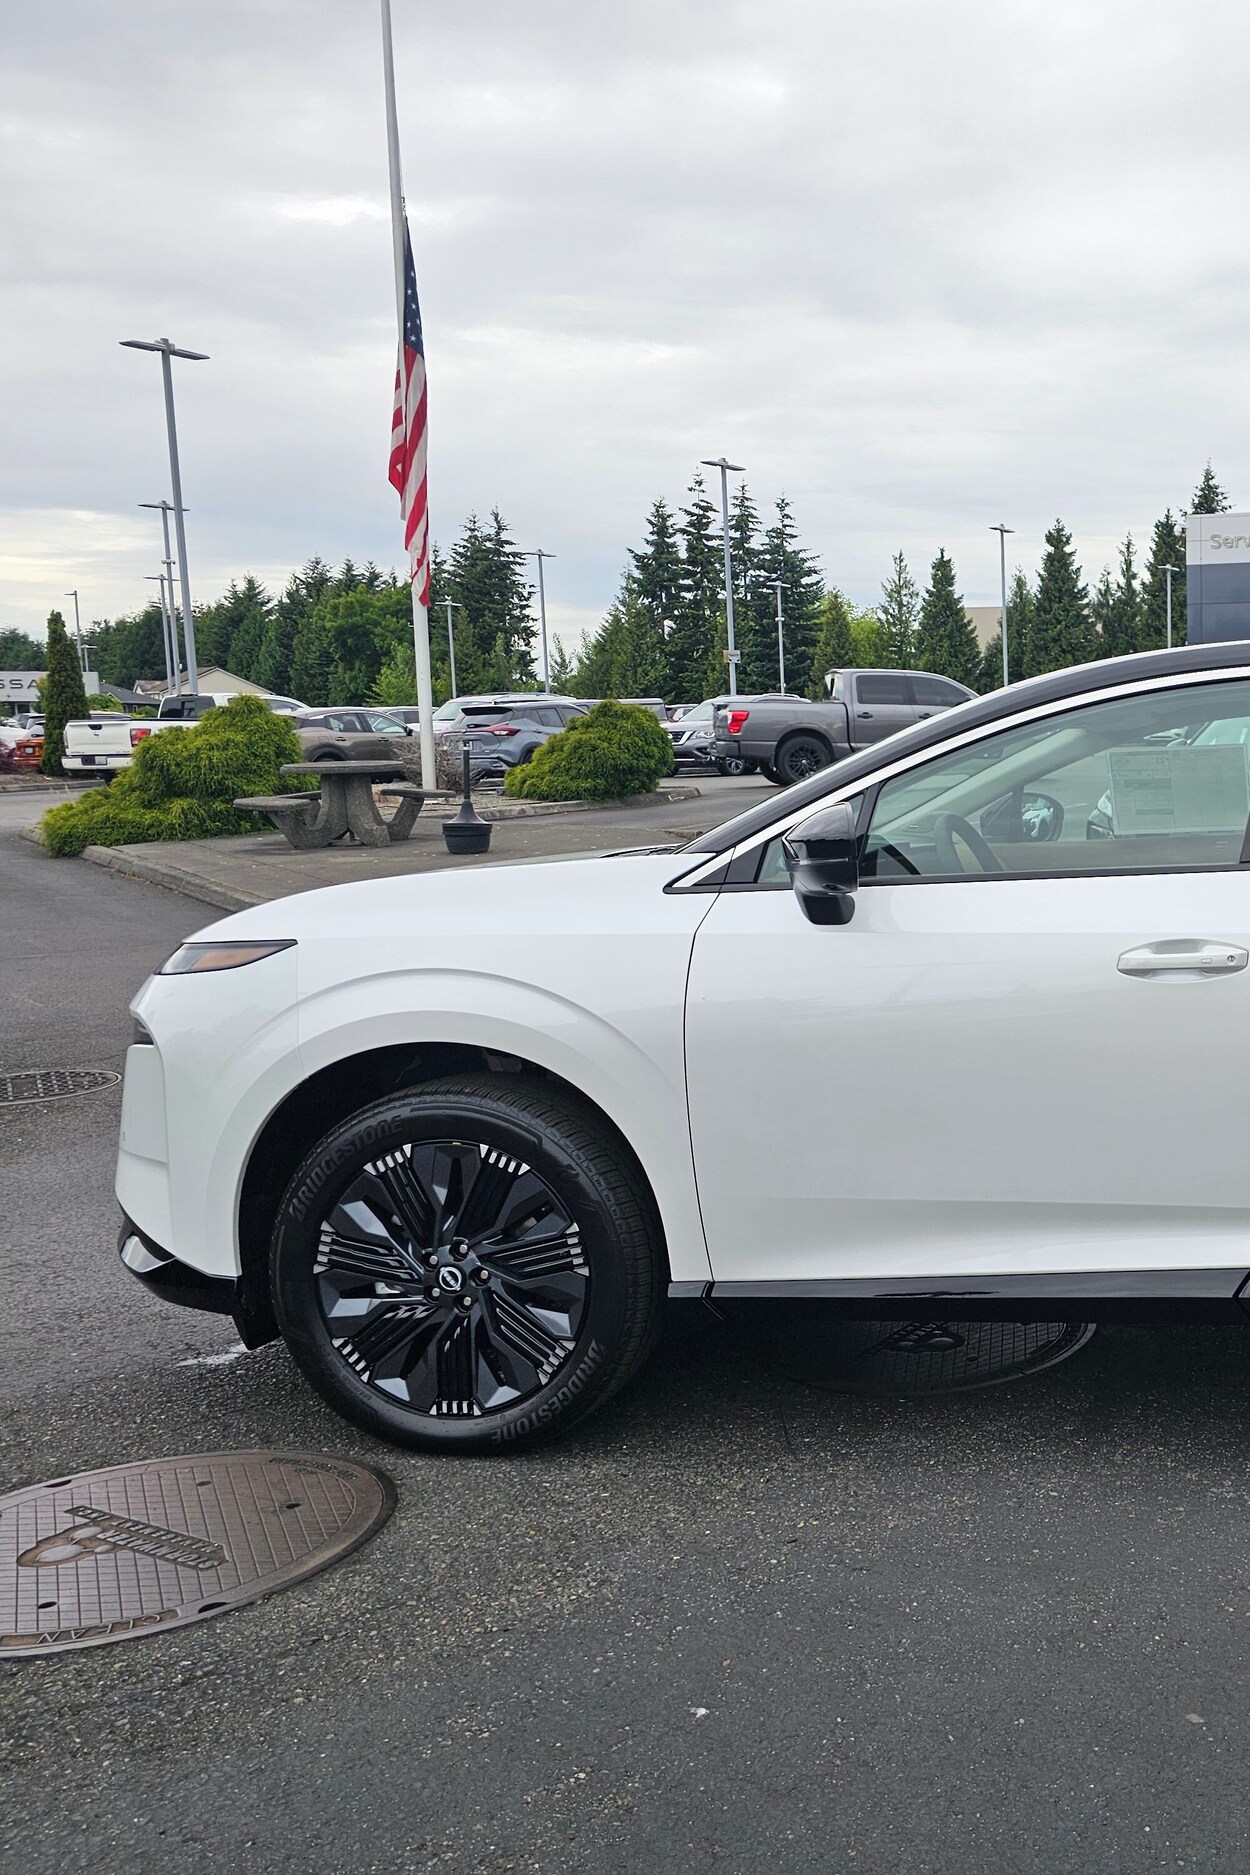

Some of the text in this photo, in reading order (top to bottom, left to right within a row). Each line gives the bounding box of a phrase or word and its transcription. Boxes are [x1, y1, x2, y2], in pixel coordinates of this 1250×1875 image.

[288, 1113, 403, 1222] BRIDGESTONE
[489, 1339, 606, 1443] BRIDGESTONE
[96, 1529, 217, 1570] STORMWATER
[35, 1613, 161, 1644] CLEAN
